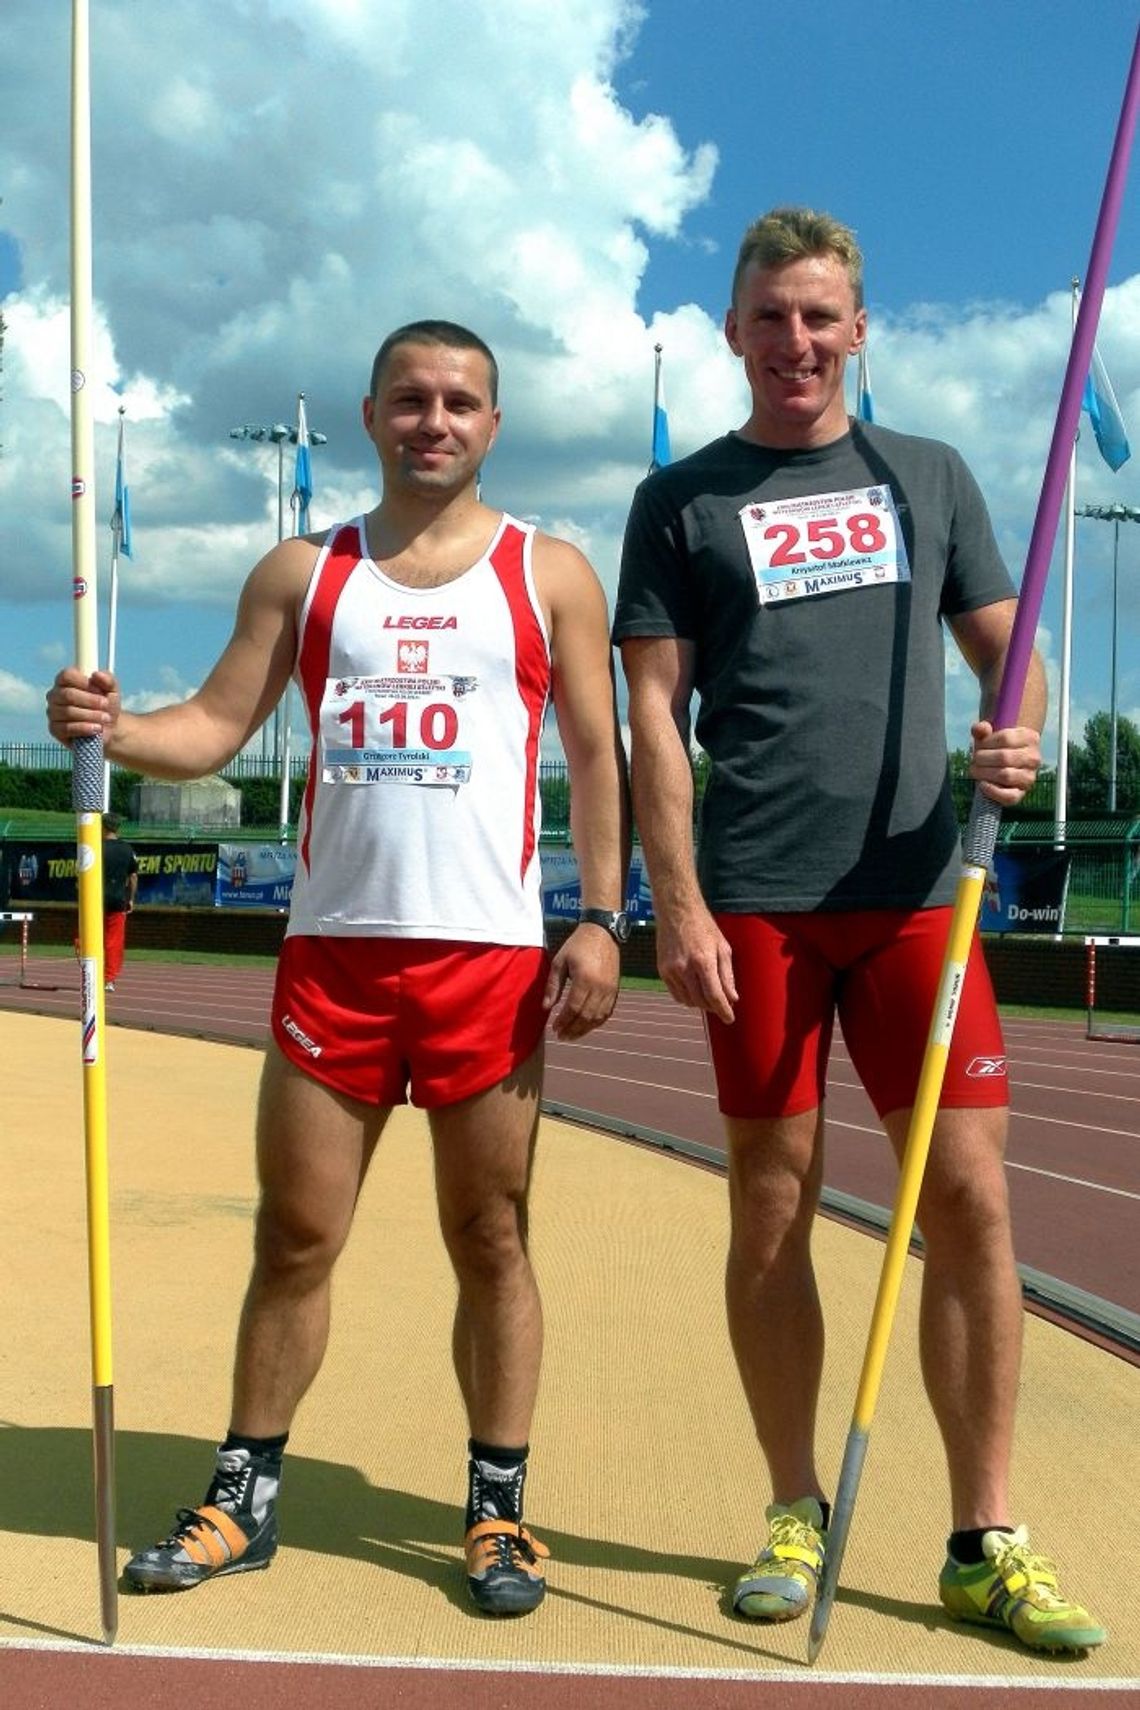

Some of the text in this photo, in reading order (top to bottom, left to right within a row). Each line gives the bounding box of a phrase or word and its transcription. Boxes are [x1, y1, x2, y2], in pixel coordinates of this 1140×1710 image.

[764, 513, 887, 567] 258
[805, 572, 863, 593] MAXIMUS
[383, 616, 458, 630] LEGEA
[339, 701, 458, 750] 110
[366, 767, 423, 781] MAXIMUS
[48, 859, 79, 878] TOR
[163, 853, 216, 873] SPORTU
[1008, 904, 1059, 920] Do-win
[282, 1015, 321, 1058] LEGEA
